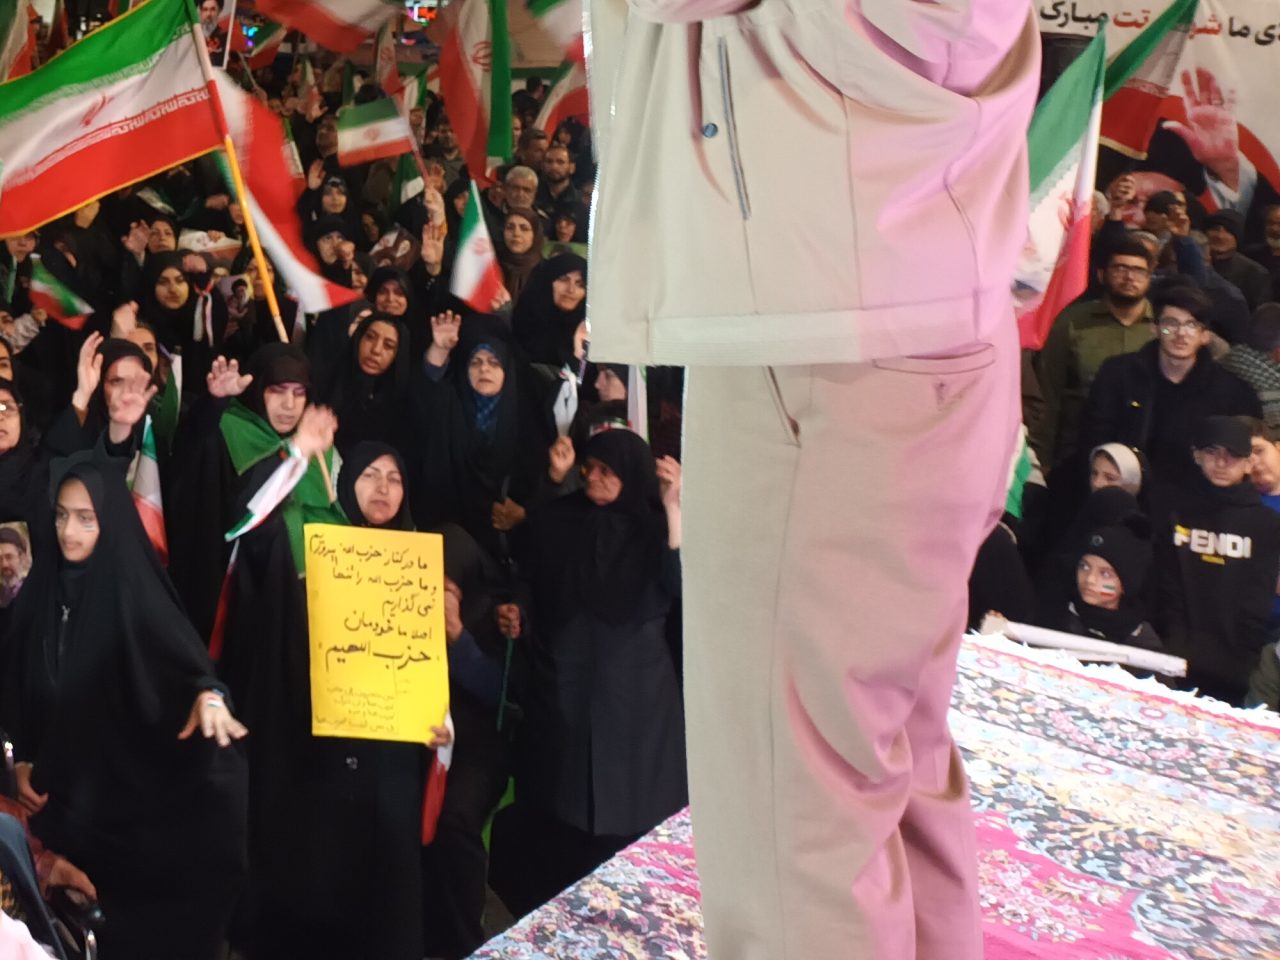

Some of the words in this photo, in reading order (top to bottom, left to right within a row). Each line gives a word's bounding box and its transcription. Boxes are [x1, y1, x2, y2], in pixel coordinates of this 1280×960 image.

[1040, 0, 1108, 29] مبارک
[1229, 16, 1250, 38] ما
[1173, 524, 1252, 559] FENDI
[417, 555, 428, 570] ما
[356, 570, 363, 585] را
[384, 575, 414, 592] حزب
[419, 577, 428, 590] ما
[344, 609, 394, 636] خودمان
[398, 625, 407, 636] ما
